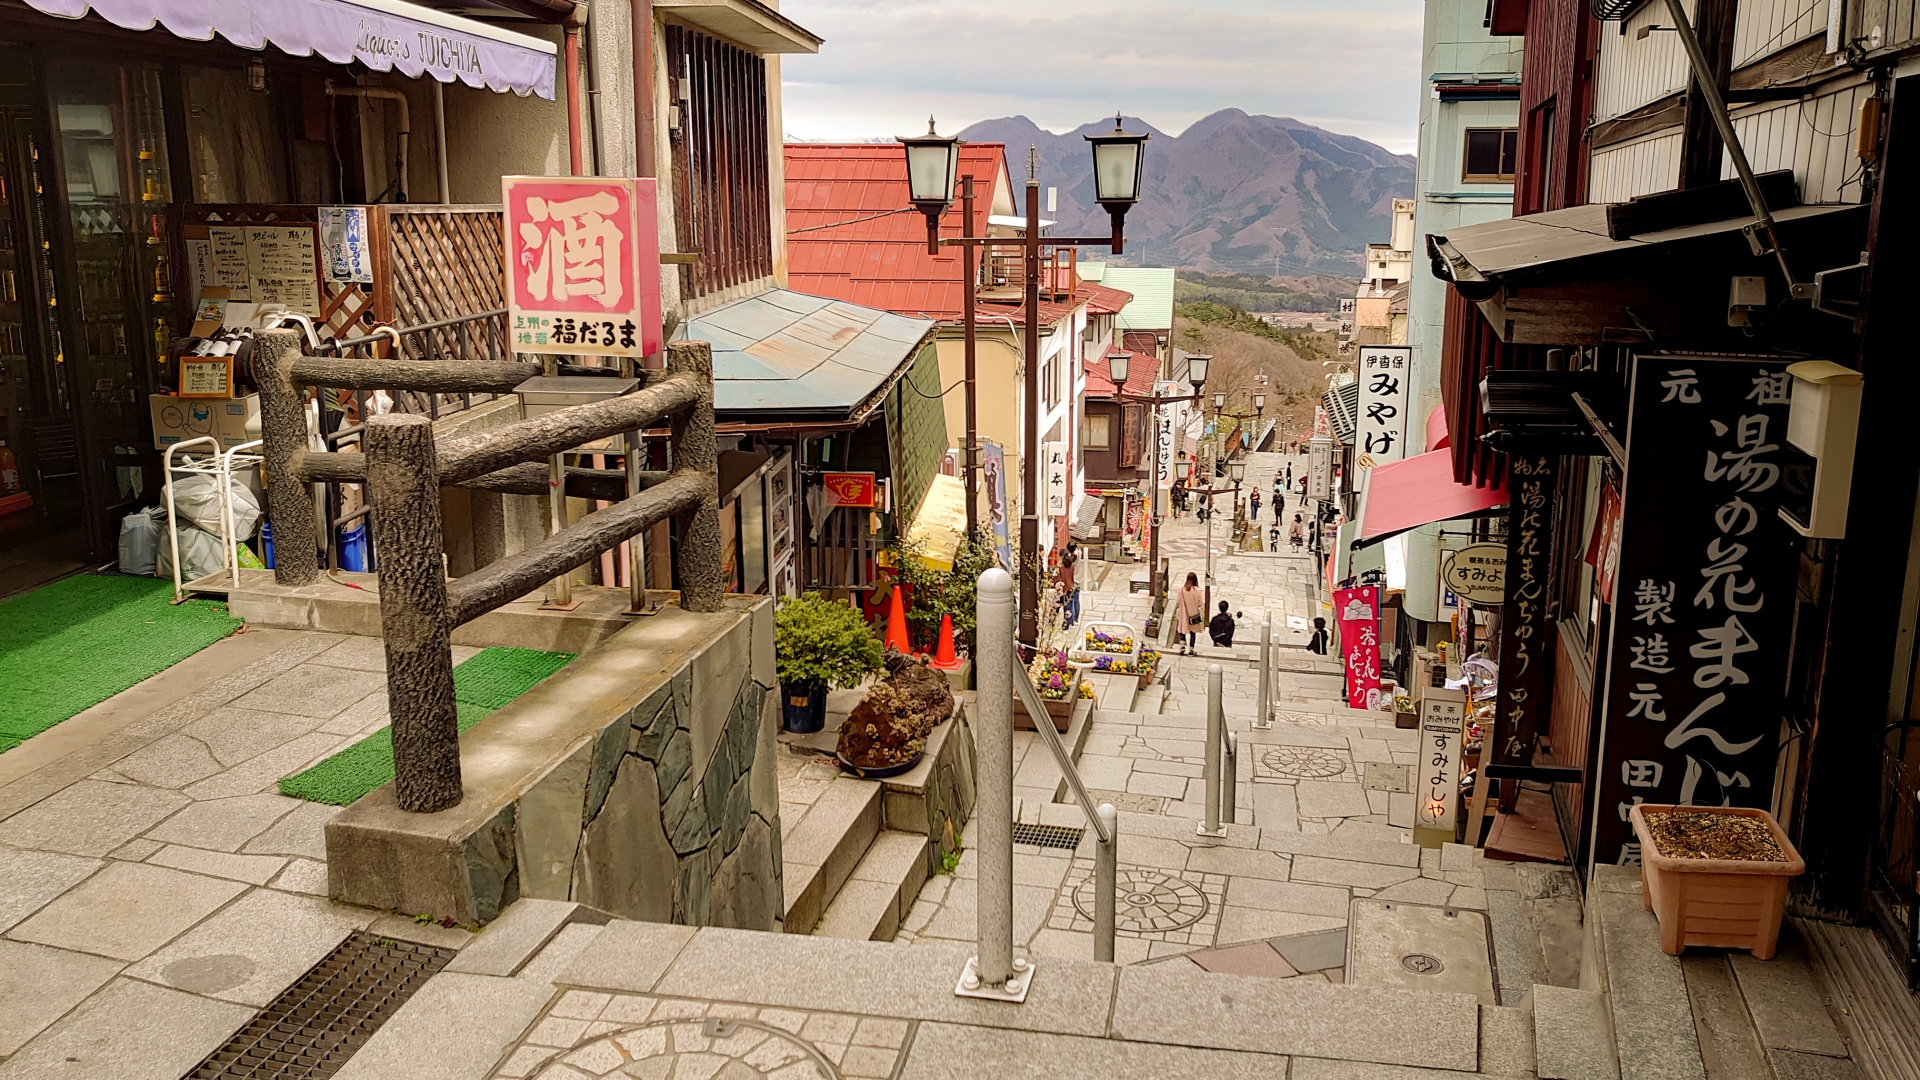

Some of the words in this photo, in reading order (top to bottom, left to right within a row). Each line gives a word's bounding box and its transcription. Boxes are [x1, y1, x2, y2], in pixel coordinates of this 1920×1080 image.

[520, 191, 624, 308] 酒
[513, 315, 550, 330] 上州の
[517, 331, 548, 345] 地酒
[550, 317, 637, 349] 福だるま
[1366, 355, 1404, 369] 伊香保
[1364, 373, 1399, 455] みやげ
[1359, 625, 1380, 680] 湯の花
[1625, 578, 1677, 722] 製造元
[1432, 704, 1456, 715] 喫茶
[1428, 733, 1452, 819] すみよしや
